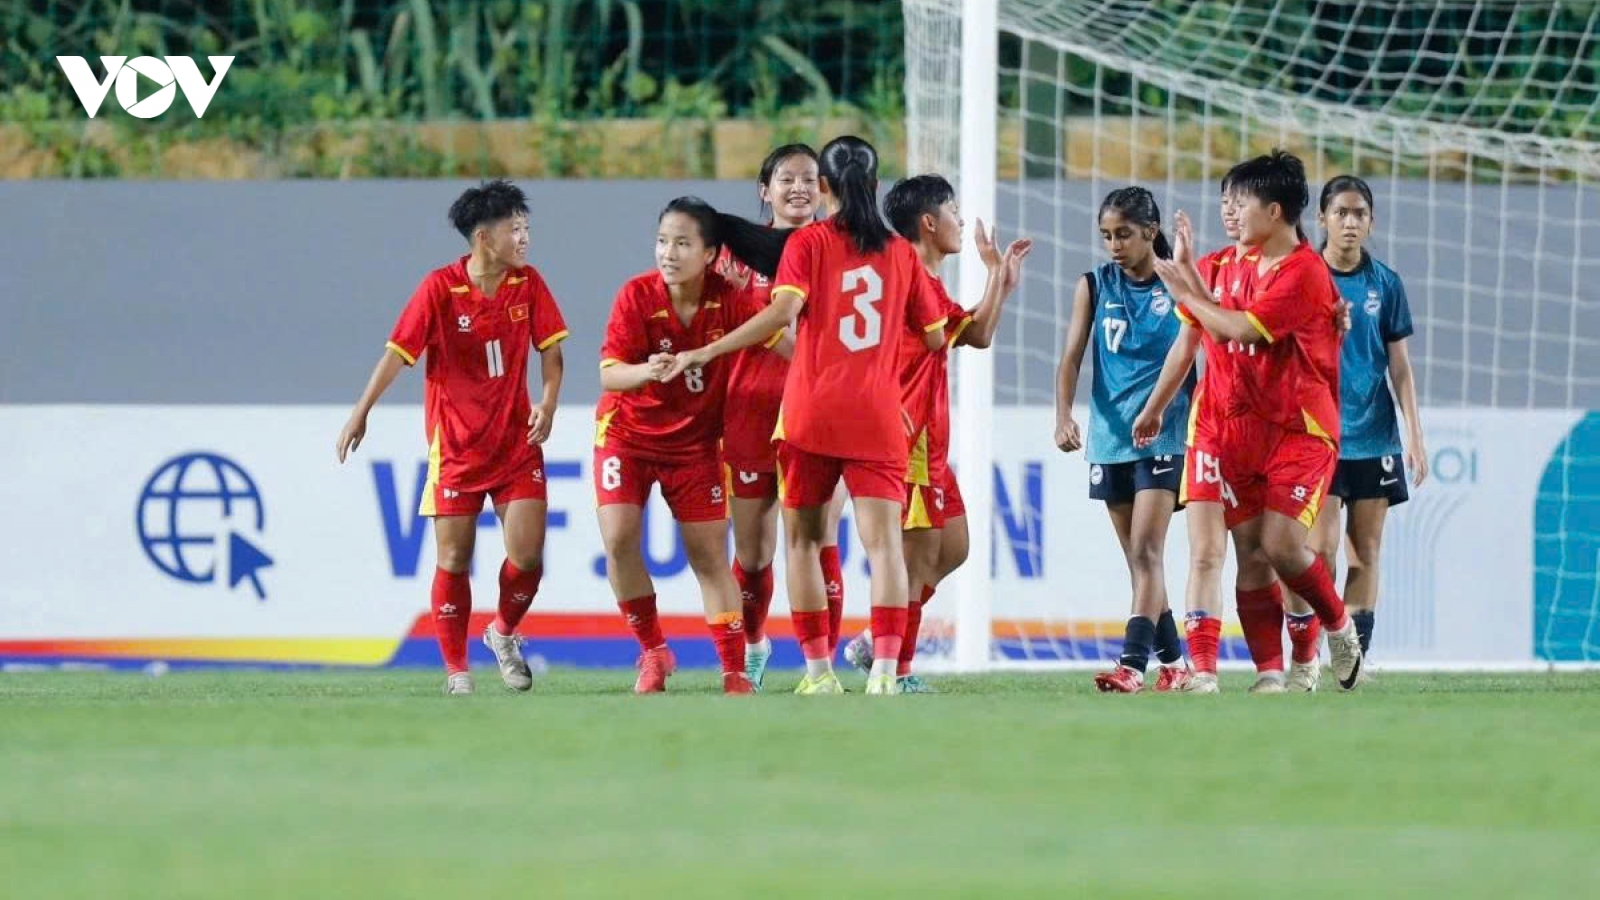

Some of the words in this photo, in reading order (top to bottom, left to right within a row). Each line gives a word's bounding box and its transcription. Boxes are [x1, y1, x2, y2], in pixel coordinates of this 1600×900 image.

[838, 264, 884, 353] 3
[1101, 317, 1129, 354] 17
[484, 338, 505, 379] 11
[683, 366, 705, 393] 8
[1195, 450, 1221, 484] 19
[1431, 446, 1478, 484] OI
